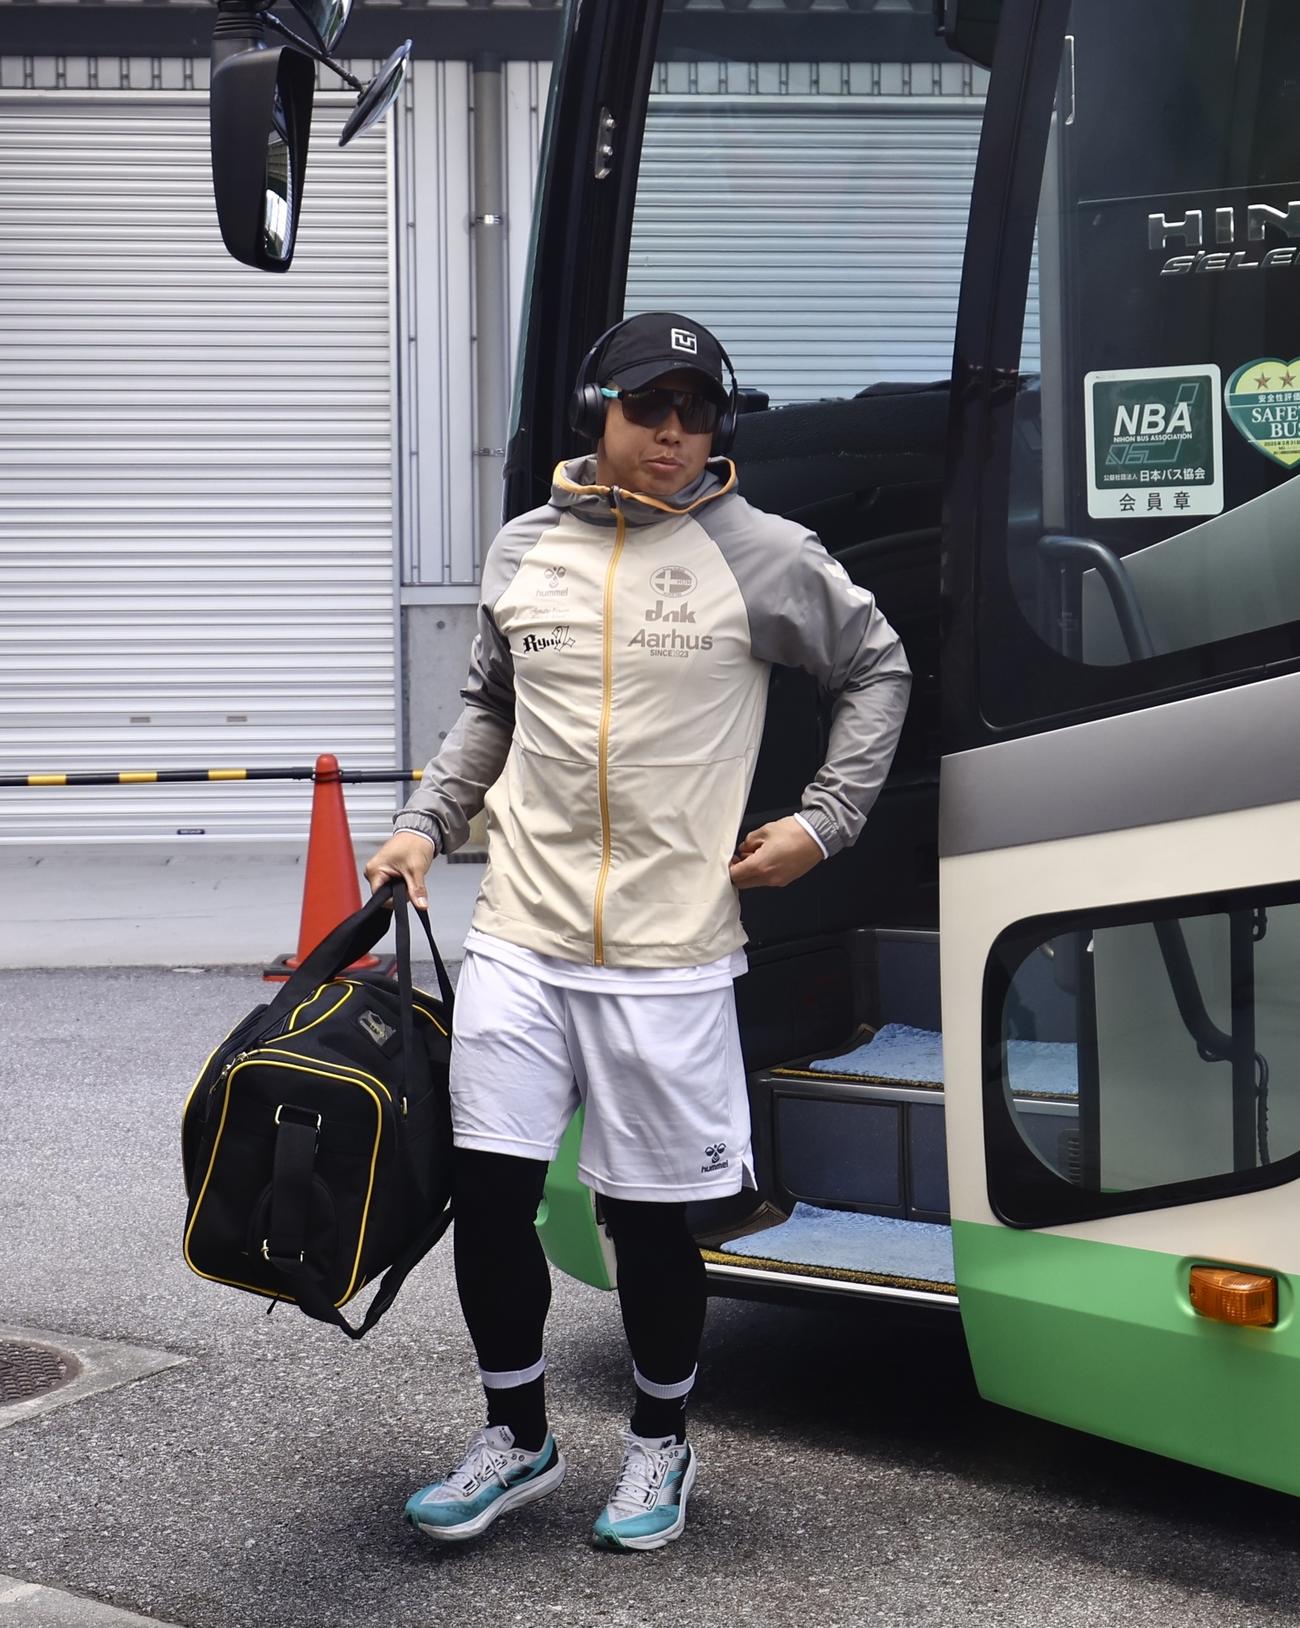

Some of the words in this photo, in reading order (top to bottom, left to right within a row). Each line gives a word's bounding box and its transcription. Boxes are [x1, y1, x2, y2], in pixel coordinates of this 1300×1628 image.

[1113, 401, 1192, 436] NBA
[1251, 405, 1300, 423] SAFE
[1137, 434, 1149, 442] BUS
[1150, 432, 1193, 441] ASSOCIATION
[1270, 421, 1300, 438] BU
[1140, 467, 1206, 482] 日本バス協会
[536, 587, 568, 598] hummel
[628, 628, 714, 651] Aarhus
[701, 1160, 728, 1173] hummel
